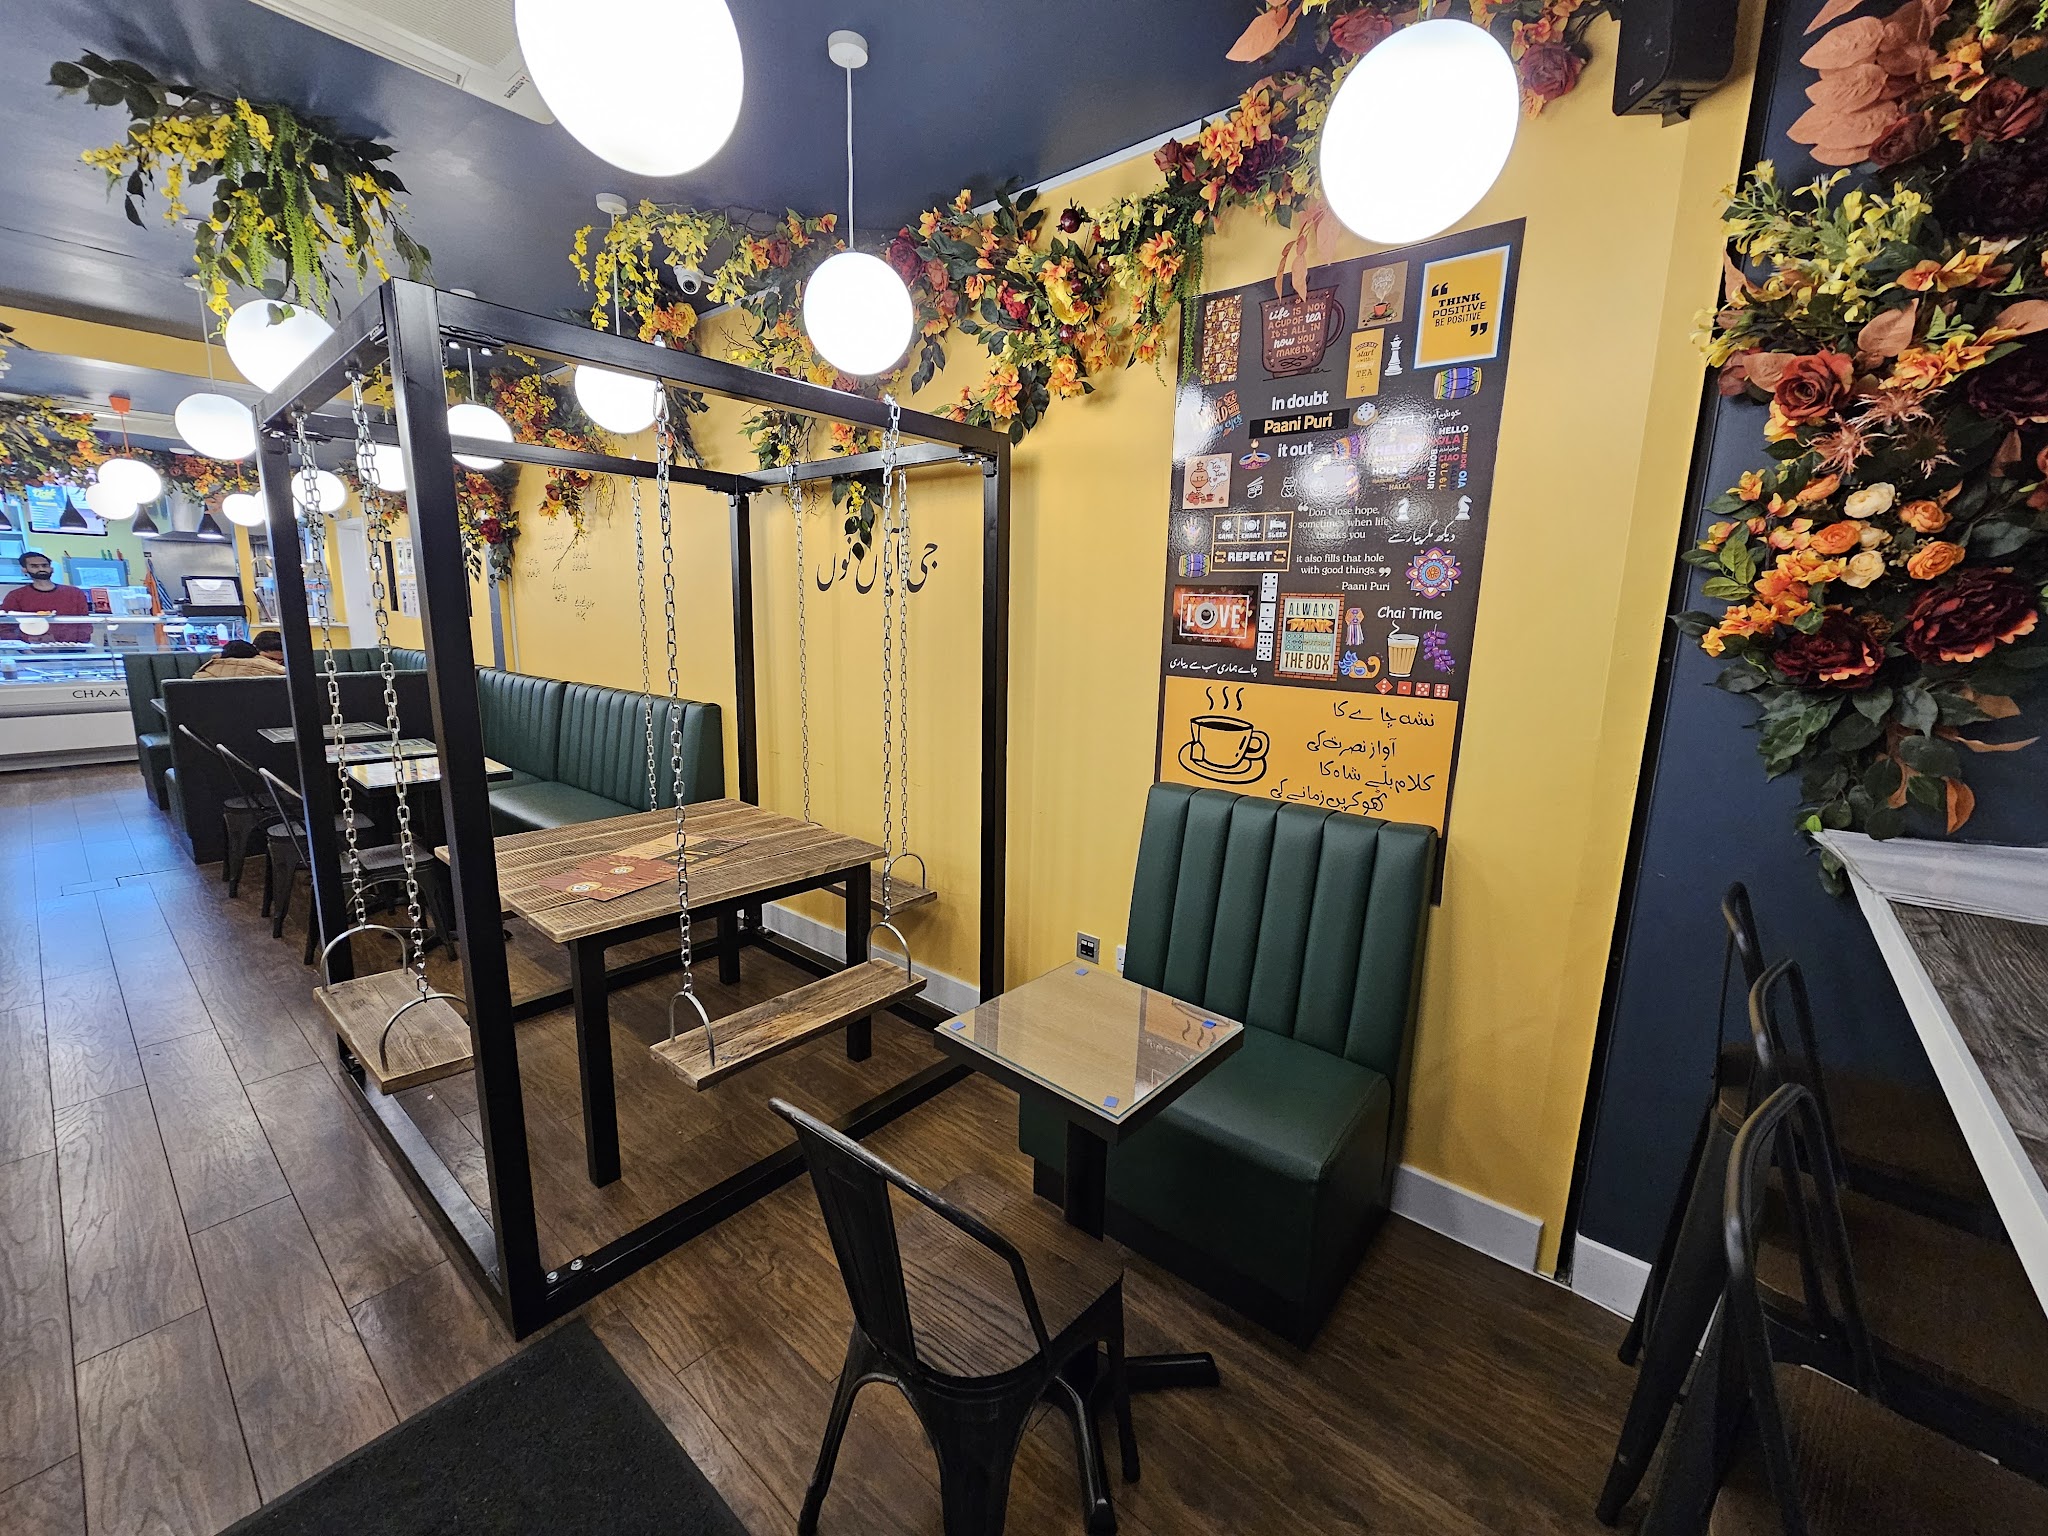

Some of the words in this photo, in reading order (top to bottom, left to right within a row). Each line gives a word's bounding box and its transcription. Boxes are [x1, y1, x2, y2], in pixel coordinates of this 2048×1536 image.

[1439, 293, 1480, 307] THINK
[1433, 301, 1487, 318] POSITIVE
[1268, 322, 1274, 330] A
[1275, 319, 1291, 328] CUP
[1292, 316, 1303, 324] OF
[1435, 318, 1445, 327] BE
[1447, 311, 1481, 325] POSITIVE
[1291, 325, 1306, 334] ALL
[1356, 369, 1373, 377] TEA
[1271, 396, 1285, 411] In
[1287, 390, 1329, 409] doubt
[1263, 416, 1302, 435] Paani
[1304, 412, 1333, 431] Puri
[1438, 425, 1469, 435] HELLO
[1277, 443, 1288, 458] it
[1289, 441, 1314, 457] out
[1438, 453, 1459, 462] CIAO
[1372, 466, 1398, 475] HOLA
[1427, 448, 1438, 490] BONJOUR
[1335, 507, 1352, 516] lose
[1298, 519, 1345, 529] sometimes
[1347, 518, 1372, 527] when
[1375, 517, 1389, 526] life
[1316, 531, 1347, 539] breaks
[1349, 531, 1366, 540] you
[1227, 551, 1273, 562] REPEAT
[1296, 554, 1302, 563] it
[1304, 554, 1322, 563] also
[1324, 553, 1340, 562] fills
[1342, 553, 1361, 562] that
[1364, 553, 1385, 562] hole
[1300, 565, 1319, 574] with
[1321, 565, 1343, 576] good
[1341, 581, 1367, 590] Paani
[1369, 581, 1390, 590] Puri
[1288, 602, 1334, 616] ALWAYS
[1377, 606, 1406, 619] Chai
[1409, 607, 1443, 620] Time
[1287, 618, 1334, 633] THINK
[1285, 652, 1304, 668] THE
[1306, 653, 1330, 670] BOX
